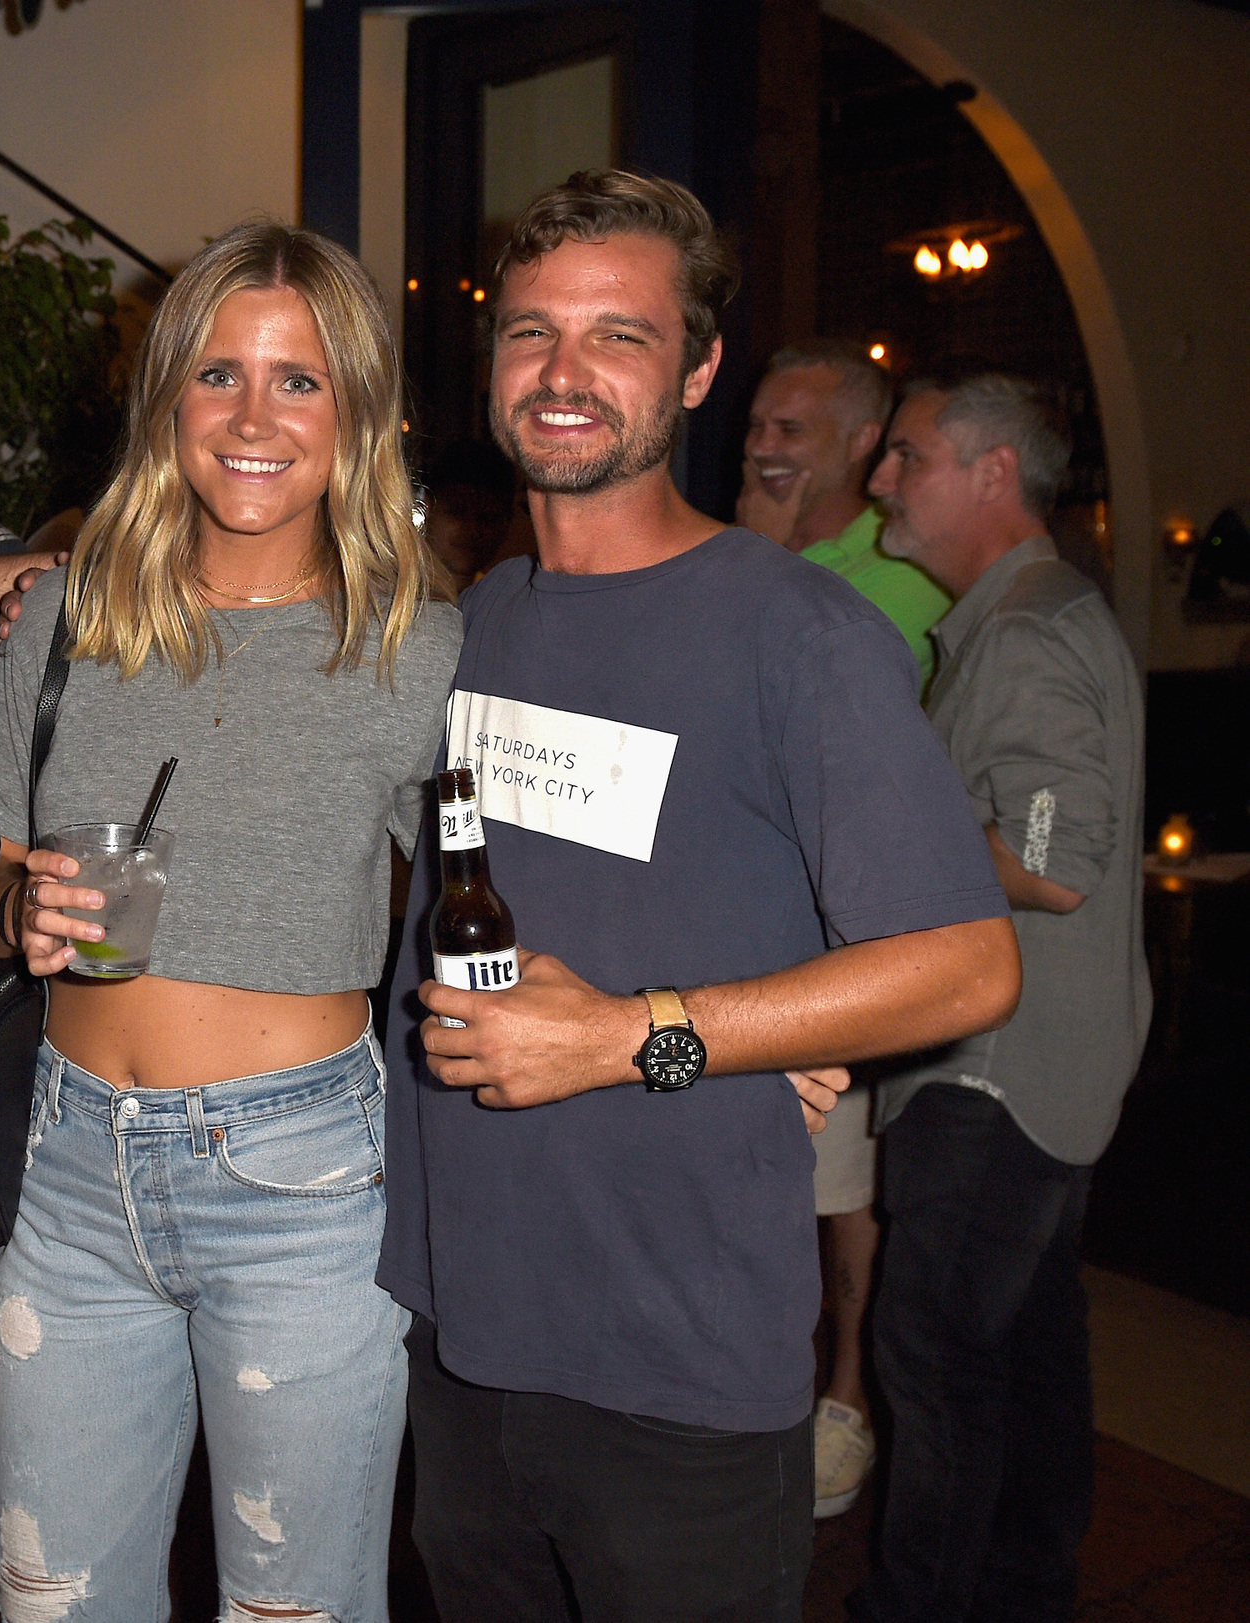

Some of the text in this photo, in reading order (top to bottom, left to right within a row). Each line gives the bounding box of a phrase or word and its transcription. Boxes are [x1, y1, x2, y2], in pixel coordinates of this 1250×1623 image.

[474, 731, 577, 770] SATURDAYS
[492, 764, 538, 791] YORK
[545, 779, 594, 804] CITY
